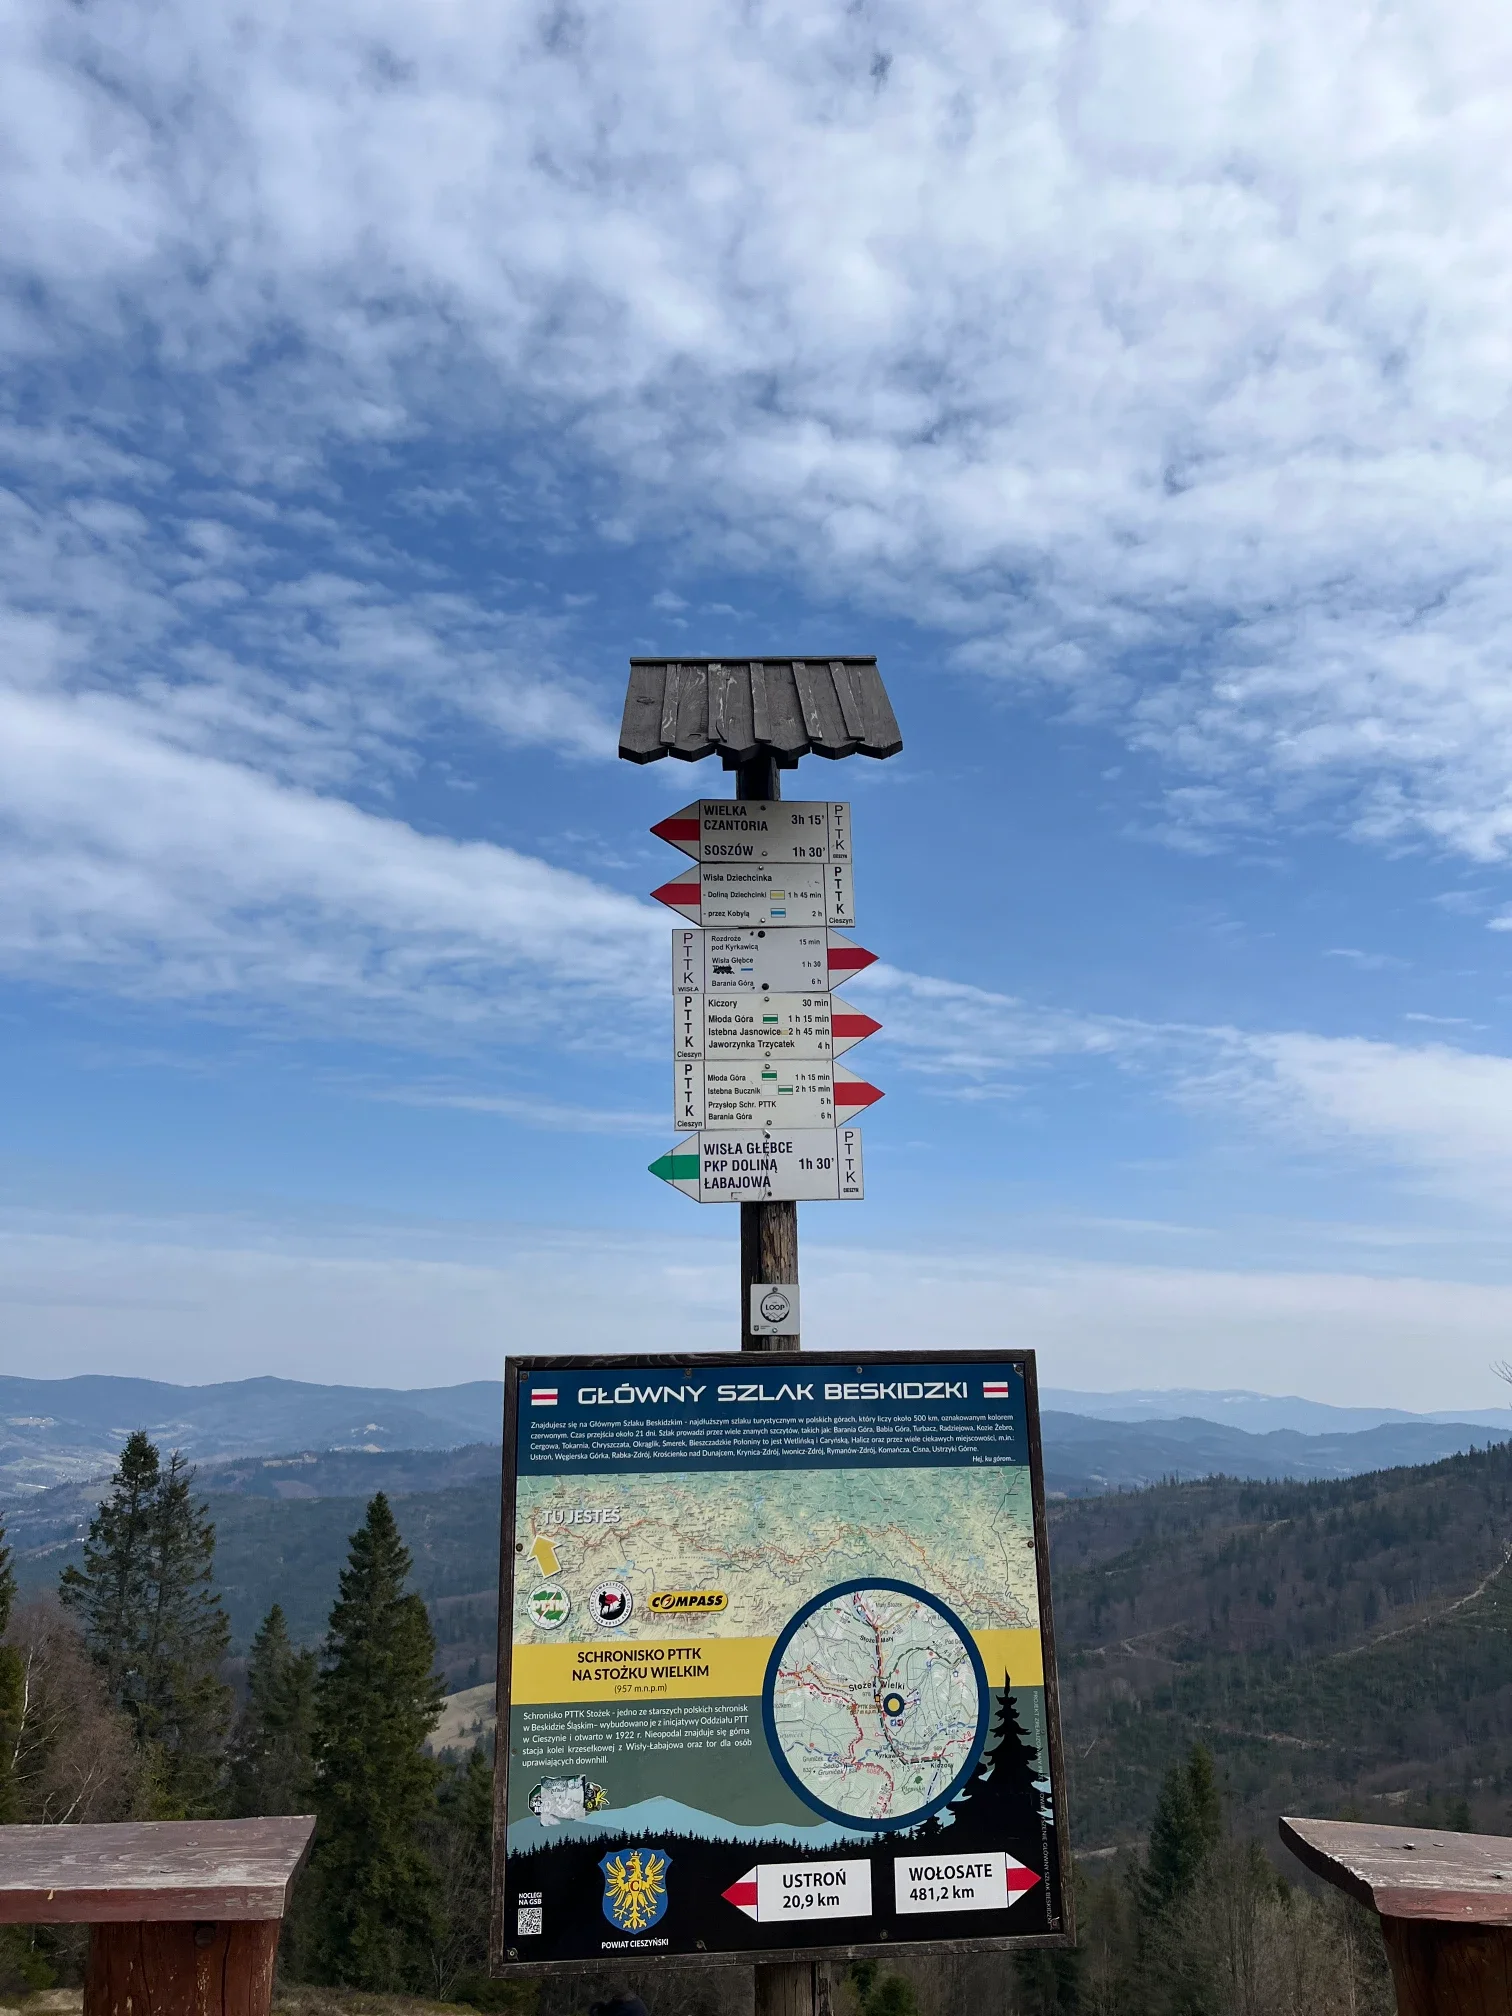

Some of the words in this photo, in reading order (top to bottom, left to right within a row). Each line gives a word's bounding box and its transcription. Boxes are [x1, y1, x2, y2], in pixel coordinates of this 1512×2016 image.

[704, 806, 747, 816] WIELKA
[704, 820, 768, 831] CZANTORIA
[792, 815, 804, 825] 3h
[704, 843, 753, 856] SOSZÓW
[793, 847, 805, 857] 1h
[703, 874, 724, 882] Wisła
[727, 874, 772, 882] Dziechcinka
[829, 917, 853, 925] Cieszyn
[731, 957, 753, 965] Głębce
[709, 1000, 737, 1009] Kiczory
[709, 1015, 732, 1023] Młoda
[734, 1015, 754, 1023] Góra
[709, 1028, 737, 1036] Istebna
[740, 1028, 781, 1036] Jasnowice
[709, 1041, 755, 1050] Jaworzynka
[758, 1040, 795, 1049] Trzycatek
[735, 1087, 760, 1095] Bucznik
[708, 1101, 737, 1109] Przysłop
[704, 1143, 743, 1155] WISŁA
[747, 1142, 793, 1155] GŁĘBCE
[704, 1161, 727, 1172] PKP
[732, 1159, 778, 1173] DOLINĄ
[799, 1159, 813, 1169] 1h
[704, 1177, 771, 1189] ŁABAJOWA
[578, 1383, 707, 1405] GŁÓWNY
[717, 1384, 814, 1402] SZLAK
[824, 1382, 968, 1400] BESKIDZKI
[543, 1510, 564, 1524] TU
[567, 1507, 621, 1524] JESTEŚ
[652, 1594, 723, 1609] COMPASS
[577, 1649, 664, 1663] SCHRONISKO
[668, 1648, 702, 1660] PTTK
[572, 1669, 592, 1681] NA
[594, 1665, 647, 1680] STOŻKU
[651, 1665, 709, 1679] WIELKIM
[523, 1711, 562, 1720] Schronisko
[565, 1710, 585, 1718] PTTK
[587, 1709, 610, 1718] Stożek
[617, 1708, 637, 1718] jedno
[649, 1707, 682, 1716] starszych
[684, 1706, 712, 1715] polskich
[714, 1704, 748, 1713] schronisk
[532, 1722, 565, 1731] Beskidzie
[600, 1719, 648, 1728] wybudowano
[649, 1720, 656, 1728] je
[663, 1718, 699, 1727] inicjatywy
[700, 1716, 732, 1725] Oddziału
[532, 1734, 566, 1744] Cieszynie
[575, 1733, 603, 1741] otwarto
[616, 1731, 634, 1740] 1922
[645, 1729, 682, 1739] Nieopodal
[684, 1728, 714, 1738] znajduje
[717, 1728, 726, 1737] się
[729, 1727, 750, 1737] górna
[523, 1746, 543, 1756] stacja
[547, 1745, 564, 1753] kolei
[568, 1744, 615, 1753] krzesełkowej
[720, 1739, 731, 1747] dla
[522, 1757, 574, 1767] uprawiających
[576, 1755, 609, 1765] downhill.
[909, 1863, 992, 1881] WOŁOSATE
[782, 1868, 846, 1889] USTROŃ
[909, 1887, 950, 1902] 481,2
[953, 1886, 975, 1899] km
[783, 1894, 814, 1910] 20,9
[818, 1893, 840, 1907] km
[602, 1941, 629, 1949] POWIAT
[630, 1938, 669, 1948] CIESZYŃSKI
